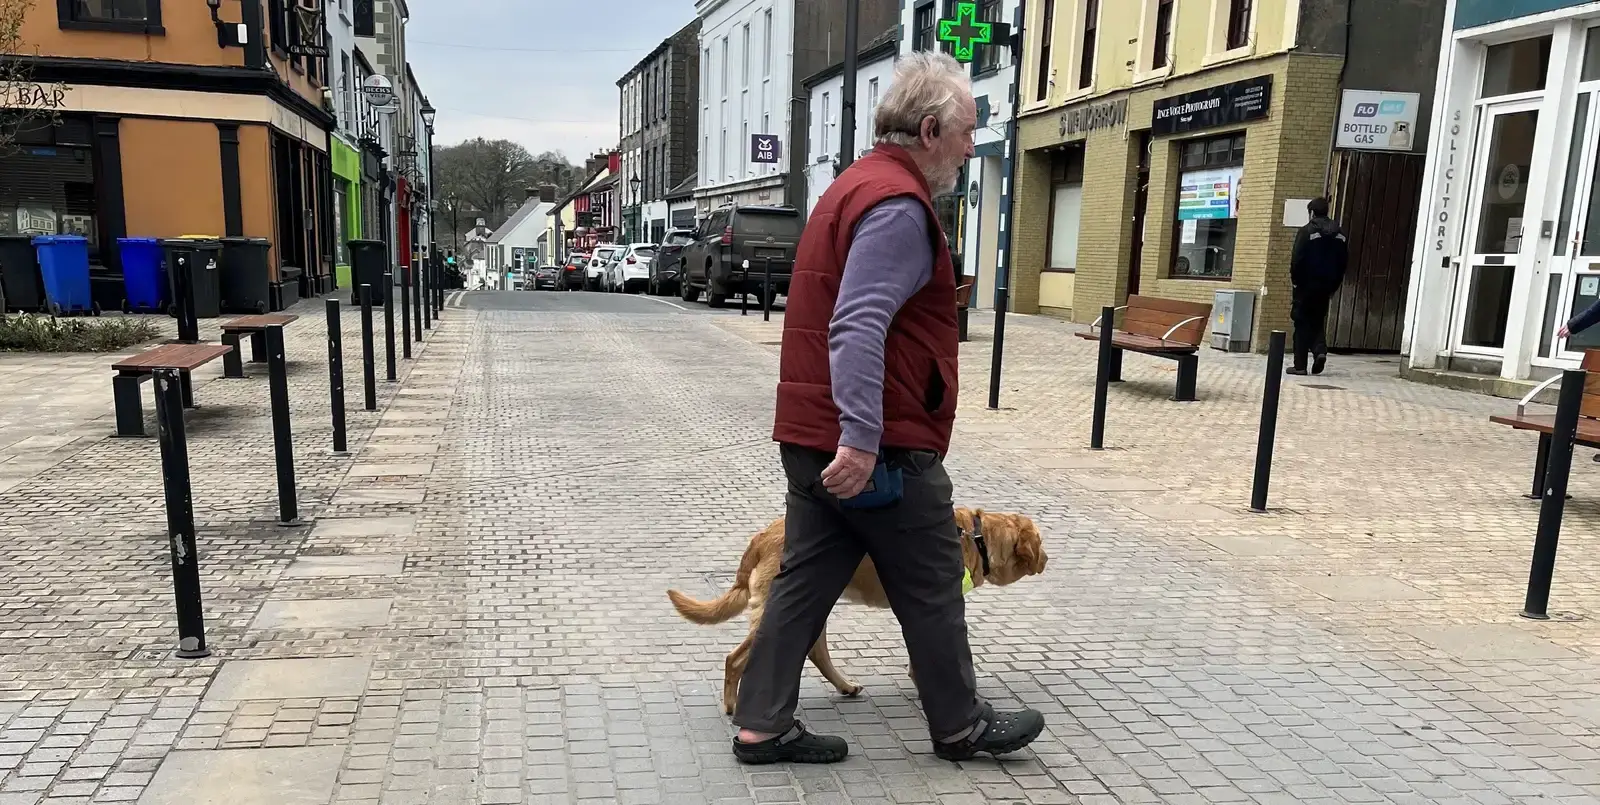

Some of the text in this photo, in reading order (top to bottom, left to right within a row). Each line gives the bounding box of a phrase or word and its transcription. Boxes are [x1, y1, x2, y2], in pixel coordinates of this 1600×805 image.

[18, 84, 66, 108] BAR
[1357, 106, 1375, 114] FLO
[1344, 123, 1388, 134] BOTTLED
[1354, 134, 1374, 144] GAS
[757, 151, 773, 160] AIB
[1436, 110, 1461, 251] SOLICITORS
